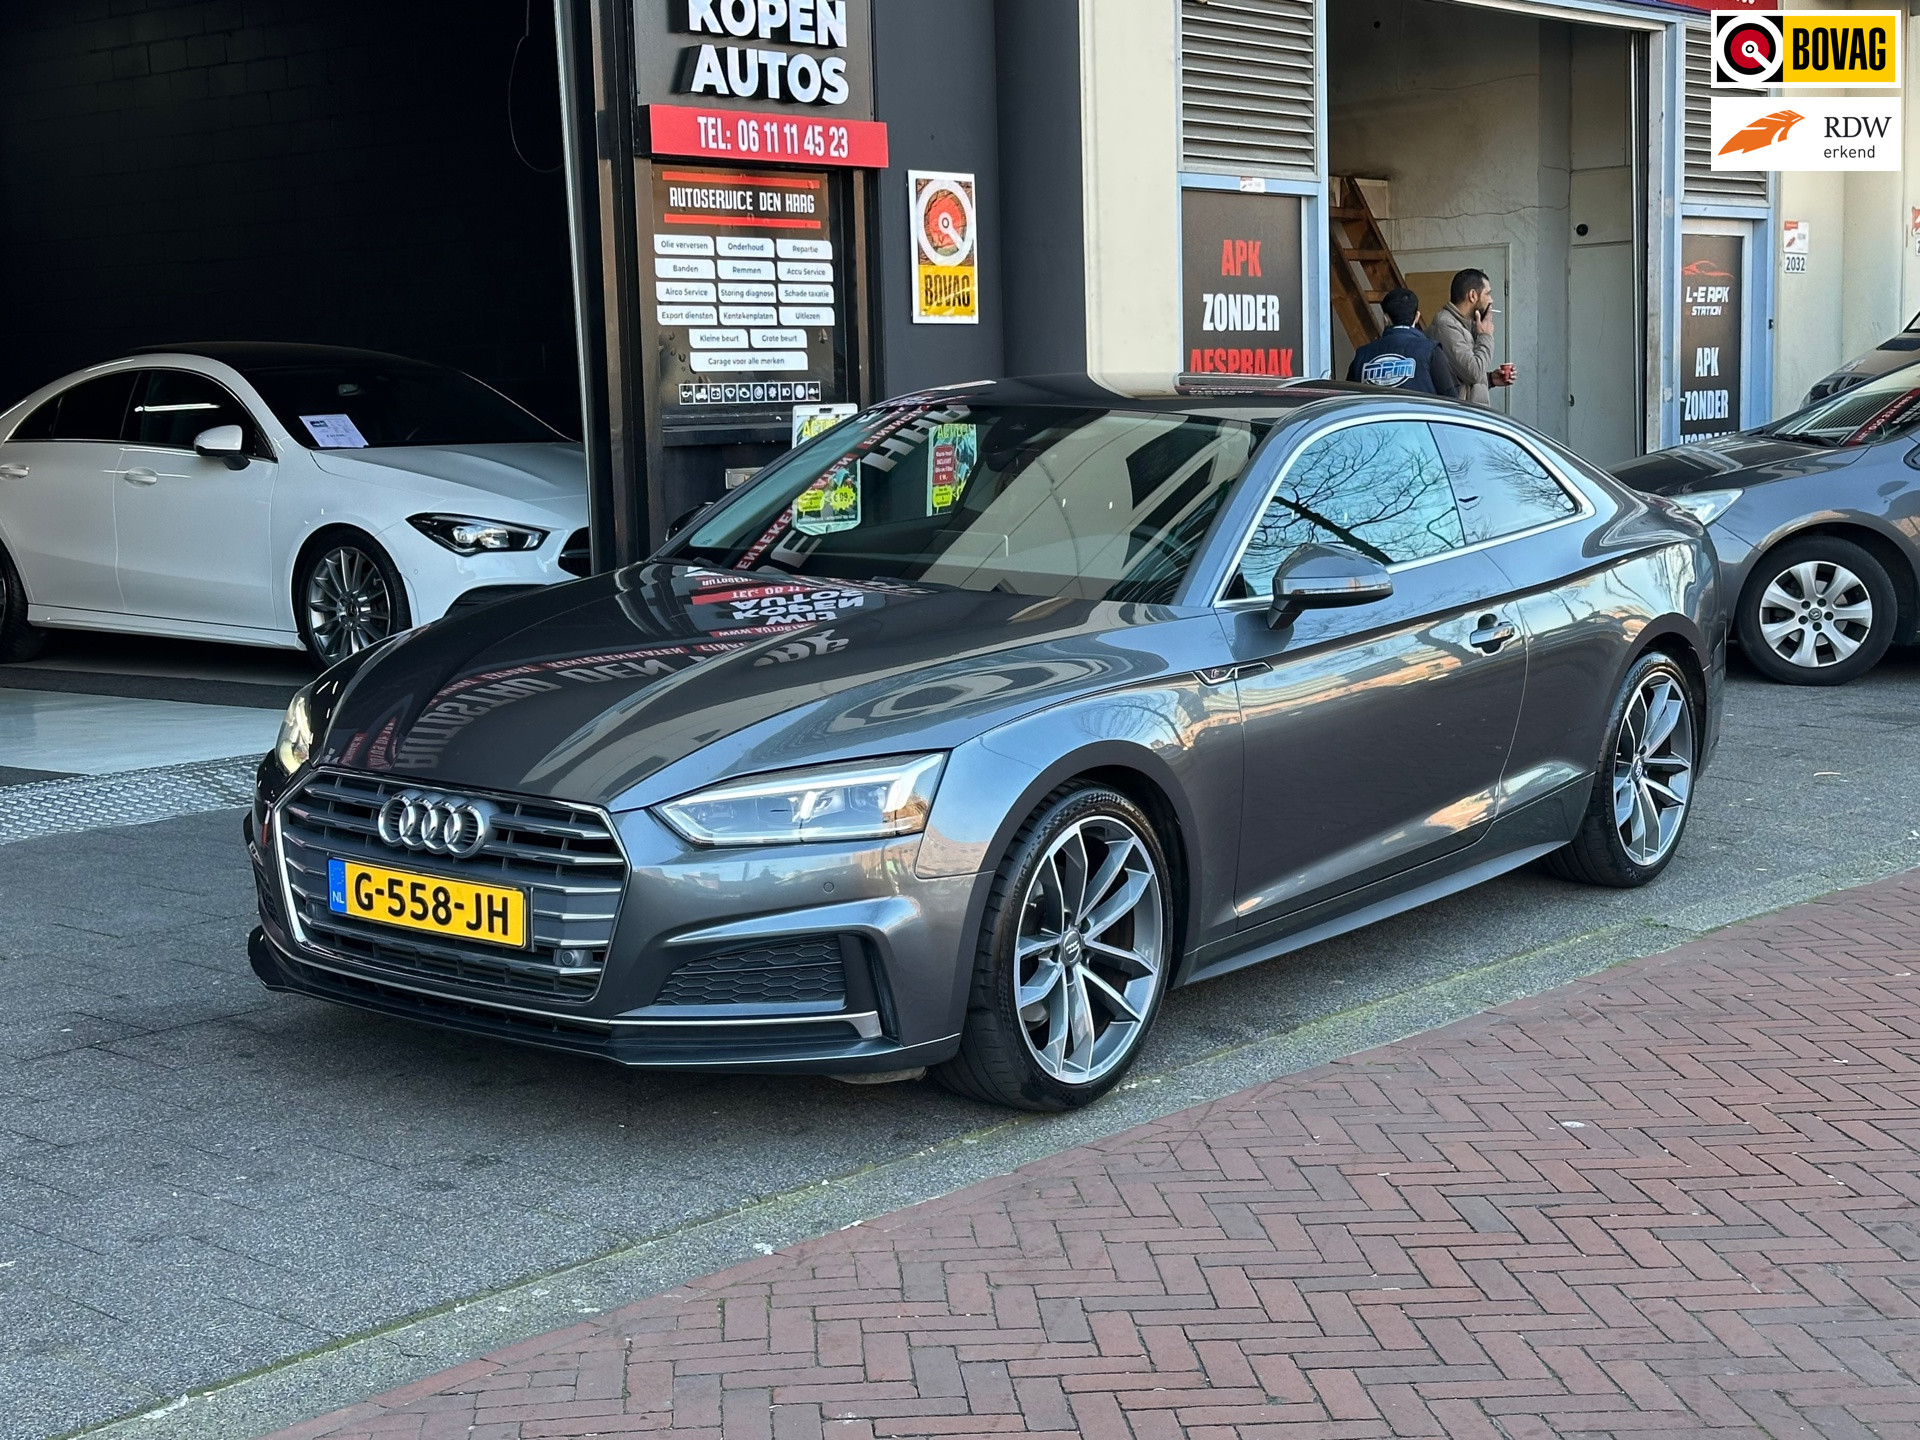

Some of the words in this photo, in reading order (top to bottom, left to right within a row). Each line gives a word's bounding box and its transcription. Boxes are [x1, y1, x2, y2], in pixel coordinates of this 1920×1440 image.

[688, 0, 848, 48] KOPEN
[690, 44, 849, 105] AUTOS
[697, 116, 731, 150] TEL:
[737, 119, 760, 153] 06
[763, 121, 779, 153] 11
[783, 123, 798, 155] 11
[803, 125, 824, 156] 45
[829, 126, 848, 158] 23
[669, 187, 754, 211] AUTOSERVICE
[759, 192, 782, 212] DEN
[785, 193, 815, 213] HAAG
[661, 240, 675, 249] Olie
[676, 241, 708, 250] verversen
[728, 242, 764, 251] Onderhoud
[1221, 239, 1262, 278] APK
[1785, 256, 1805, 272] 2032
[673, 265, 699, 273] Banden
[732, 266, 761, 274] Remmen
[787, 268, 802, 276] Accu
[803, 268, 826, 276] Service
[665, 288, 683, 296] Airco
[684, 288, 708, 297] Service
[720, 288, 744, 299] Storing
[745, 289, 774, 299] diagnose
[784, 289, 807, 298] Schade
[808, 290, 830, 298] taxatie
[924, 274, 970, 308] BOVAG
[1707, 286, 1730, 303] APK
[661, 311, 683, 321] Export
[685, 311, 714, 319] diensten
[723, 311, 774, 321] Kentekenplaten
[795, 312, 820, 320] Uitlezen
[1202, 293, 1280, 332] ZONDER
[1691, 305, 1722, 316] STATION
[700, 334, 720, 342] Kleine
[721, 334, 739, 342] beurt
[780, 334, 798, 342] beurt
[748, 357, 760, 365] alle
[760, 357, 785, 365] merken
[1695, 347, 1719, 378] APK
[1684, 389, 1729, 421] ZONDER
[332, 890, 345, 904] NL
[354, 871, 509, 937] G-558-JH
